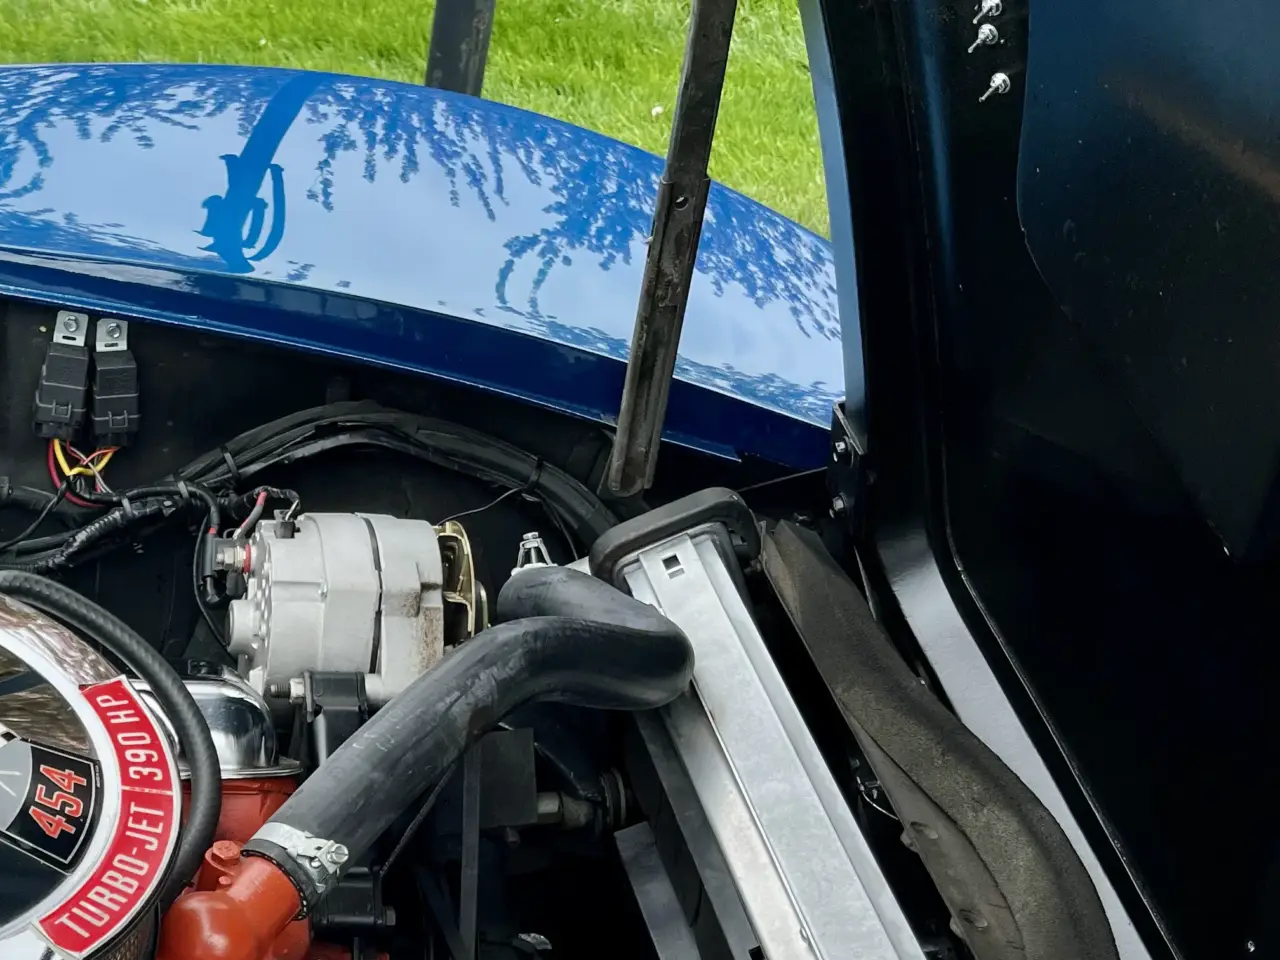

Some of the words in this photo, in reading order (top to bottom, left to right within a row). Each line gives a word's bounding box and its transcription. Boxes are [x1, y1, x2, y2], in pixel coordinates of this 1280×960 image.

[95, 694, 141, 725] HP
[117, 732, 164, 782] 390
[29, 763, 87, 839] 454
[54, 801, 165, 939] TURBO-JET
